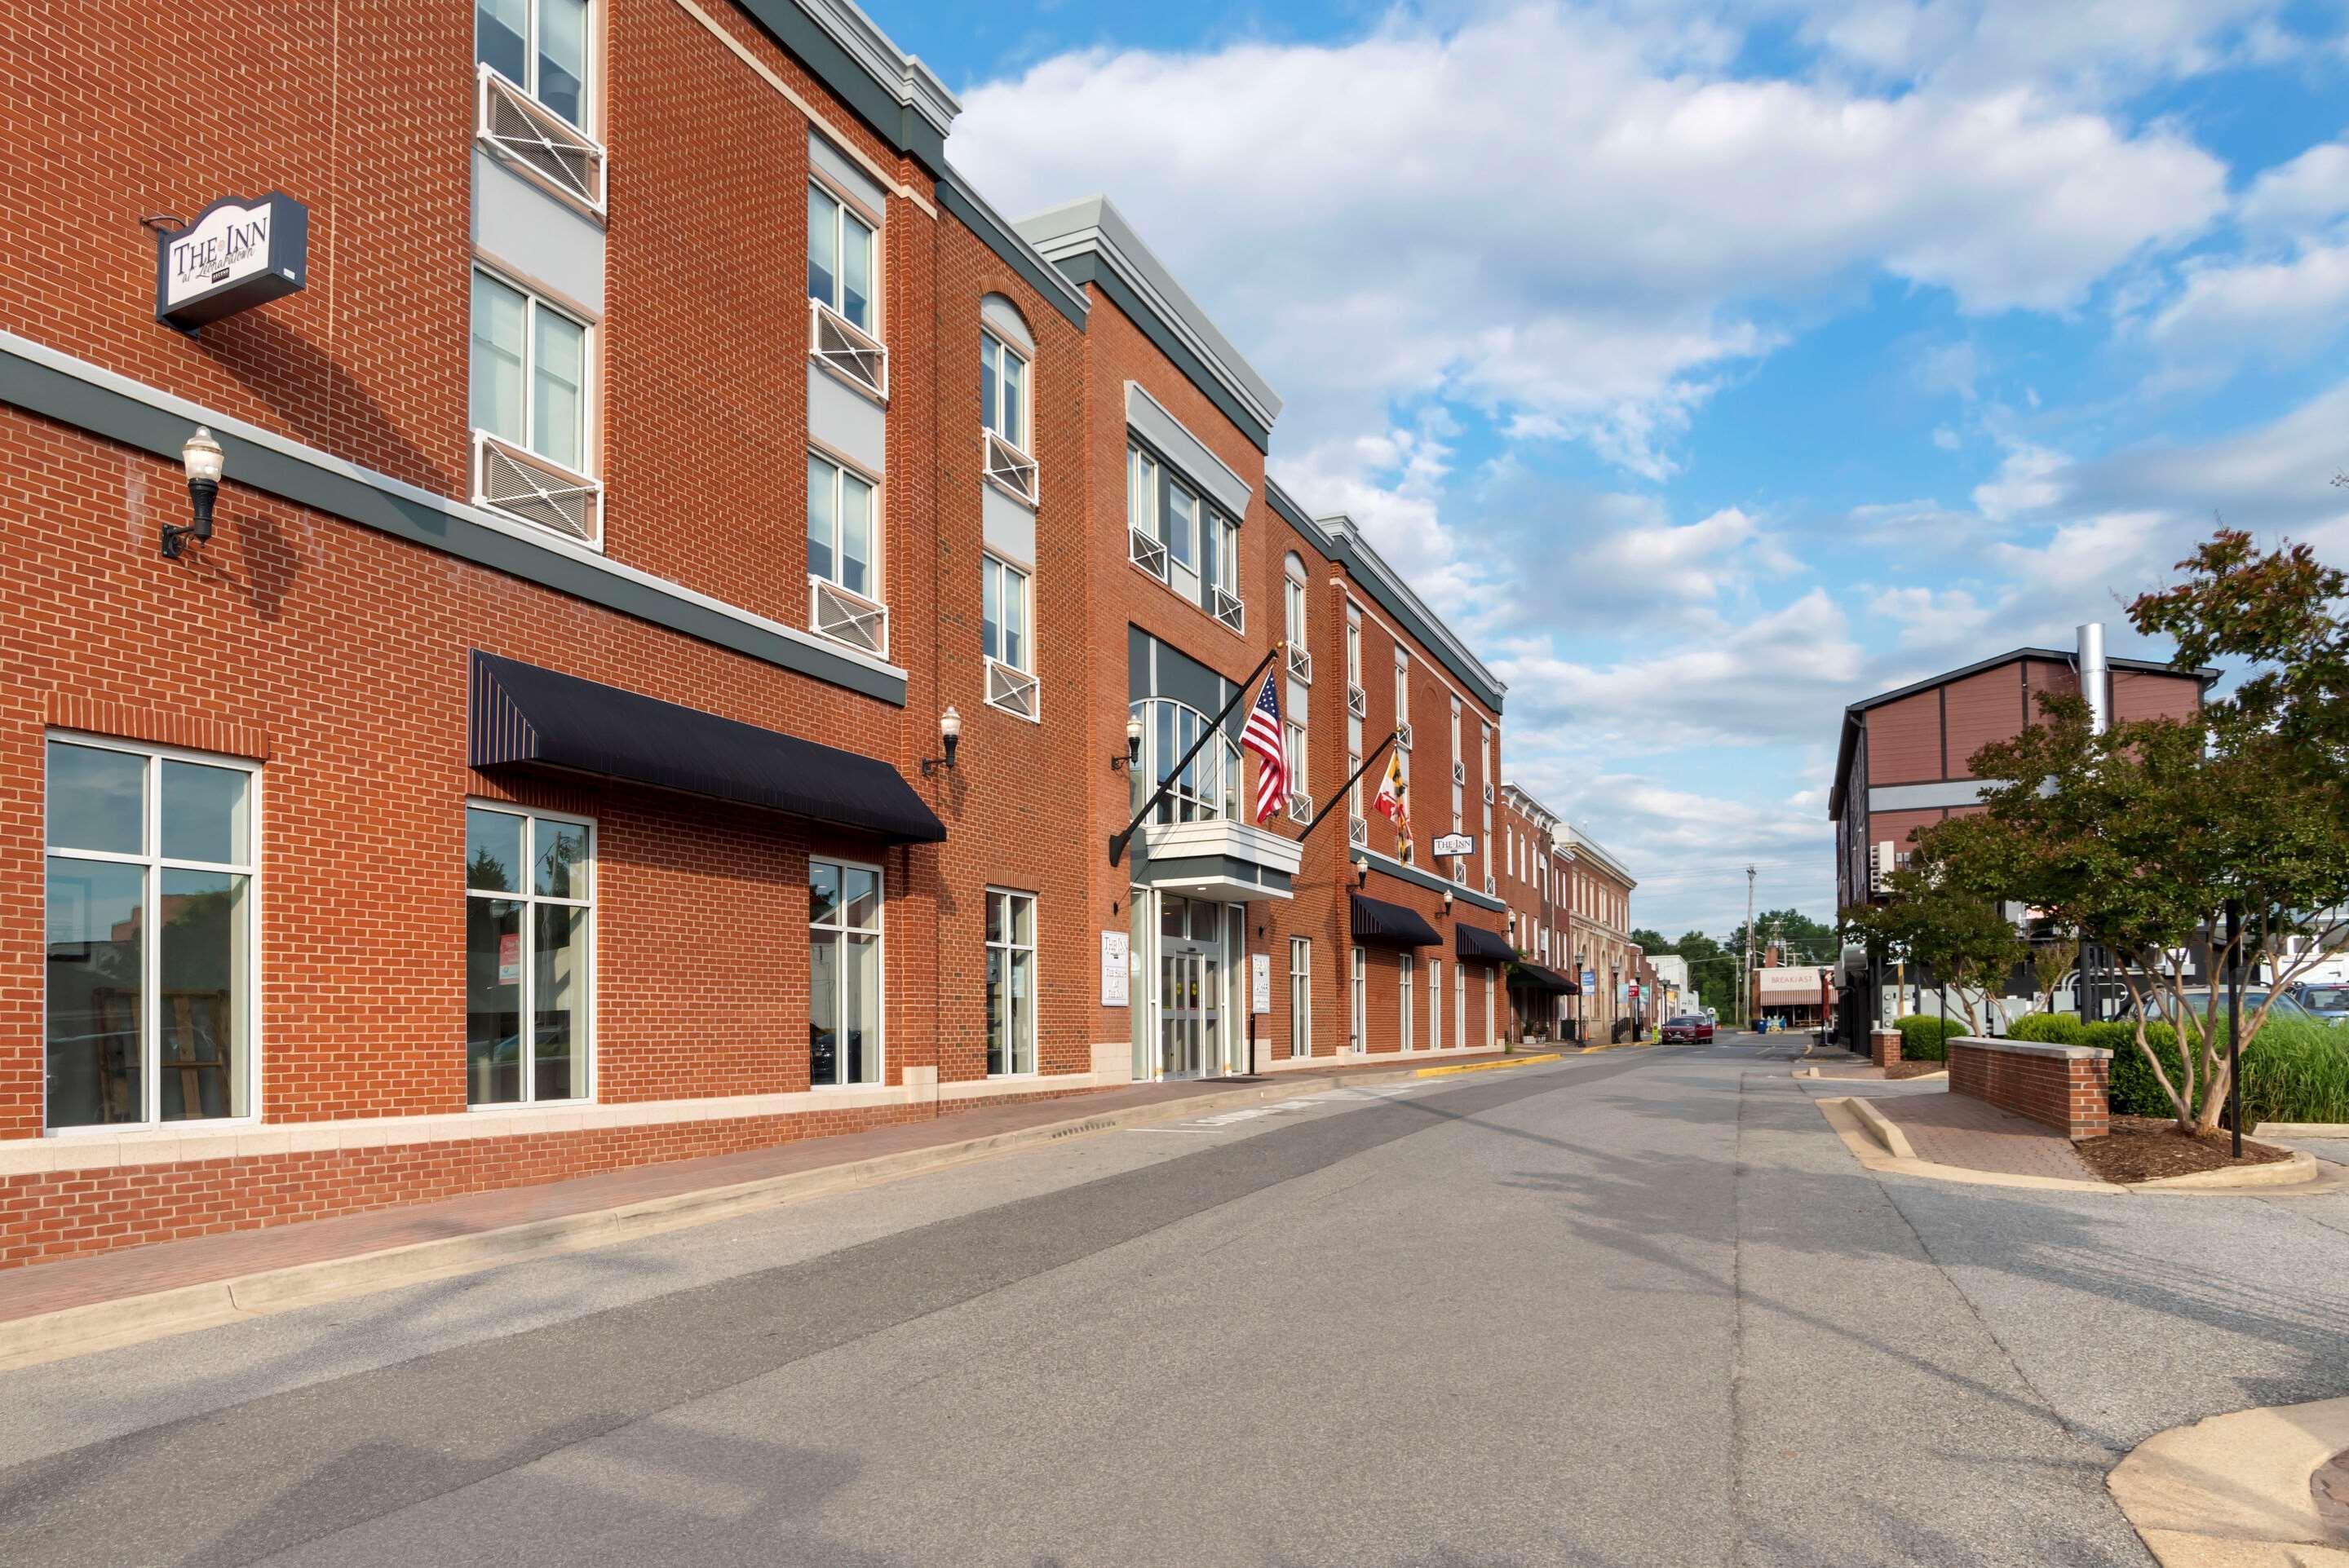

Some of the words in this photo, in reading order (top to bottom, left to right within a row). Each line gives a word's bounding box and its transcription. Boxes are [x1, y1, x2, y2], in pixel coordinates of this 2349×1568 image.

[175, 237, 217, 276] THE
[226, 217, 268, 255] INN
[1436, 840, 1453, 849] THE
[1454, 839, 1471, 849] INN
